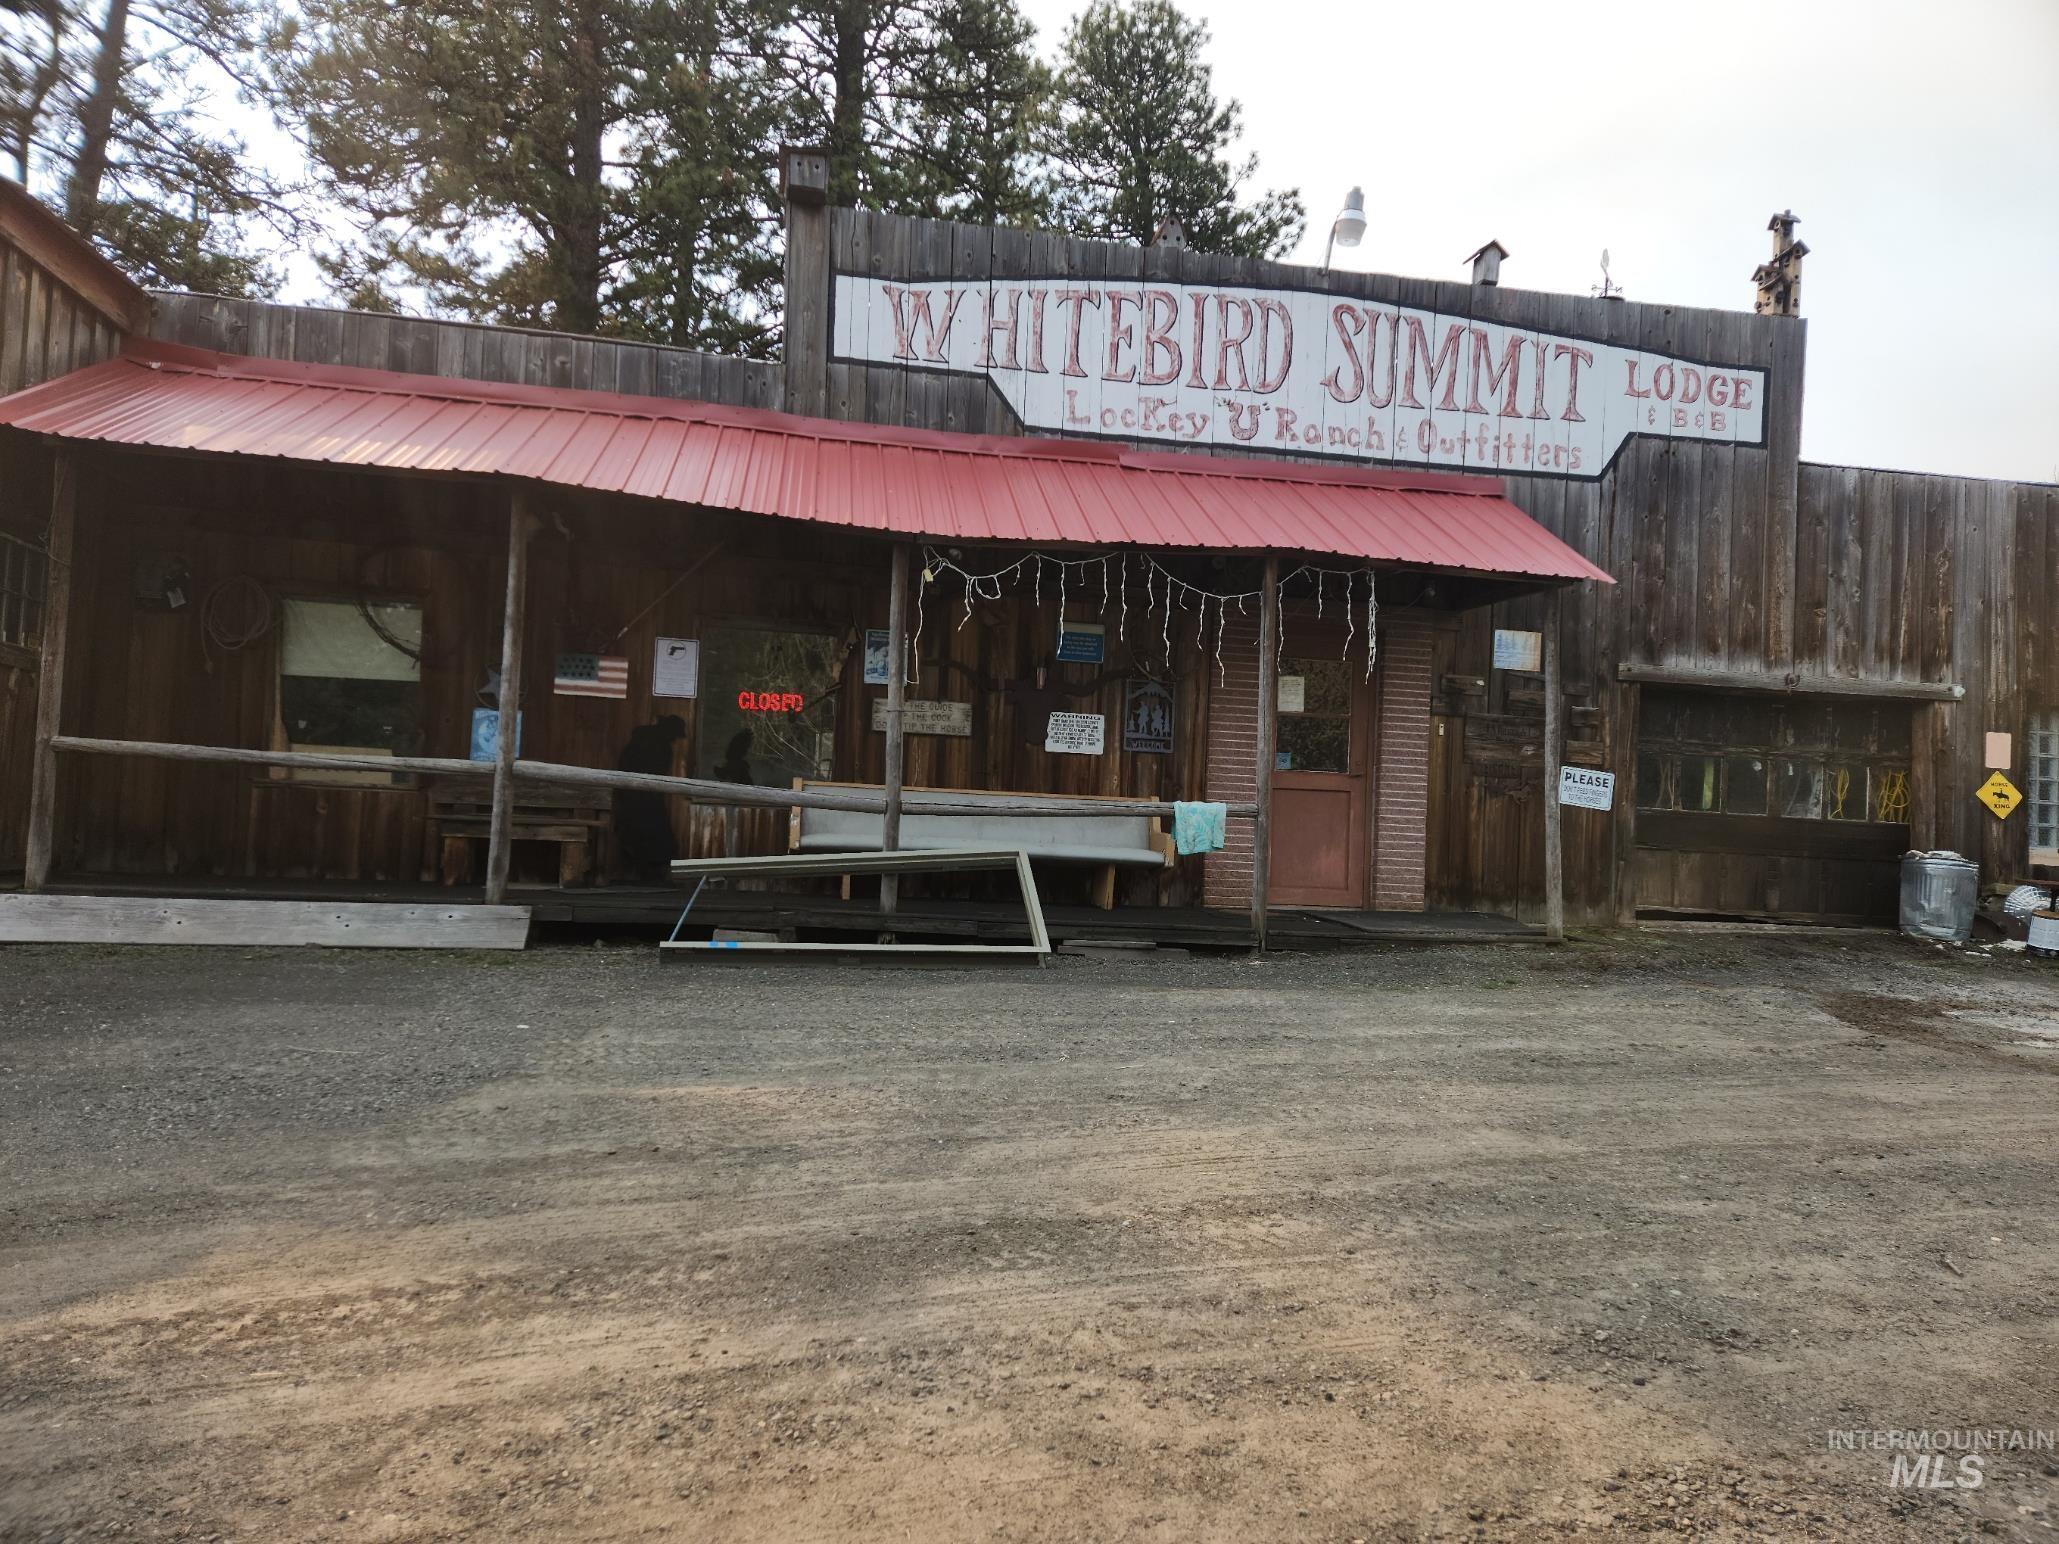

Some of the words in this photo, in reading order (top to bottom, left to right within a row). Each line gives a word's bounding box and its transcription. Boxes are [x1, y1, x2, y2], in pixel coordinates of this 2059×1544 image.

[882, 285, 1293, 394] WHITEBIRD
[1320, 303, 1593, 422] SUMMIT
[1624, 359, 1752, 410] LODGE
[1275, 406, 1385, 450] Ranch
[1417, 418, 1582, 469] Outfitters
[738, 691, 804, 712] CLOSED
[910, 703, 926, 711] THE
[928, 703, 953, 712] GUIDE
[911, 713, 927, 722] THE
[930, 713, 952, 722] COOK
[1051, 713, 1101, 721] WARNING
[920, 723, 937, 732] THE
[940, 724, 967, 734] HORSE
[1565, 771, 1610, 789] PLEASE
